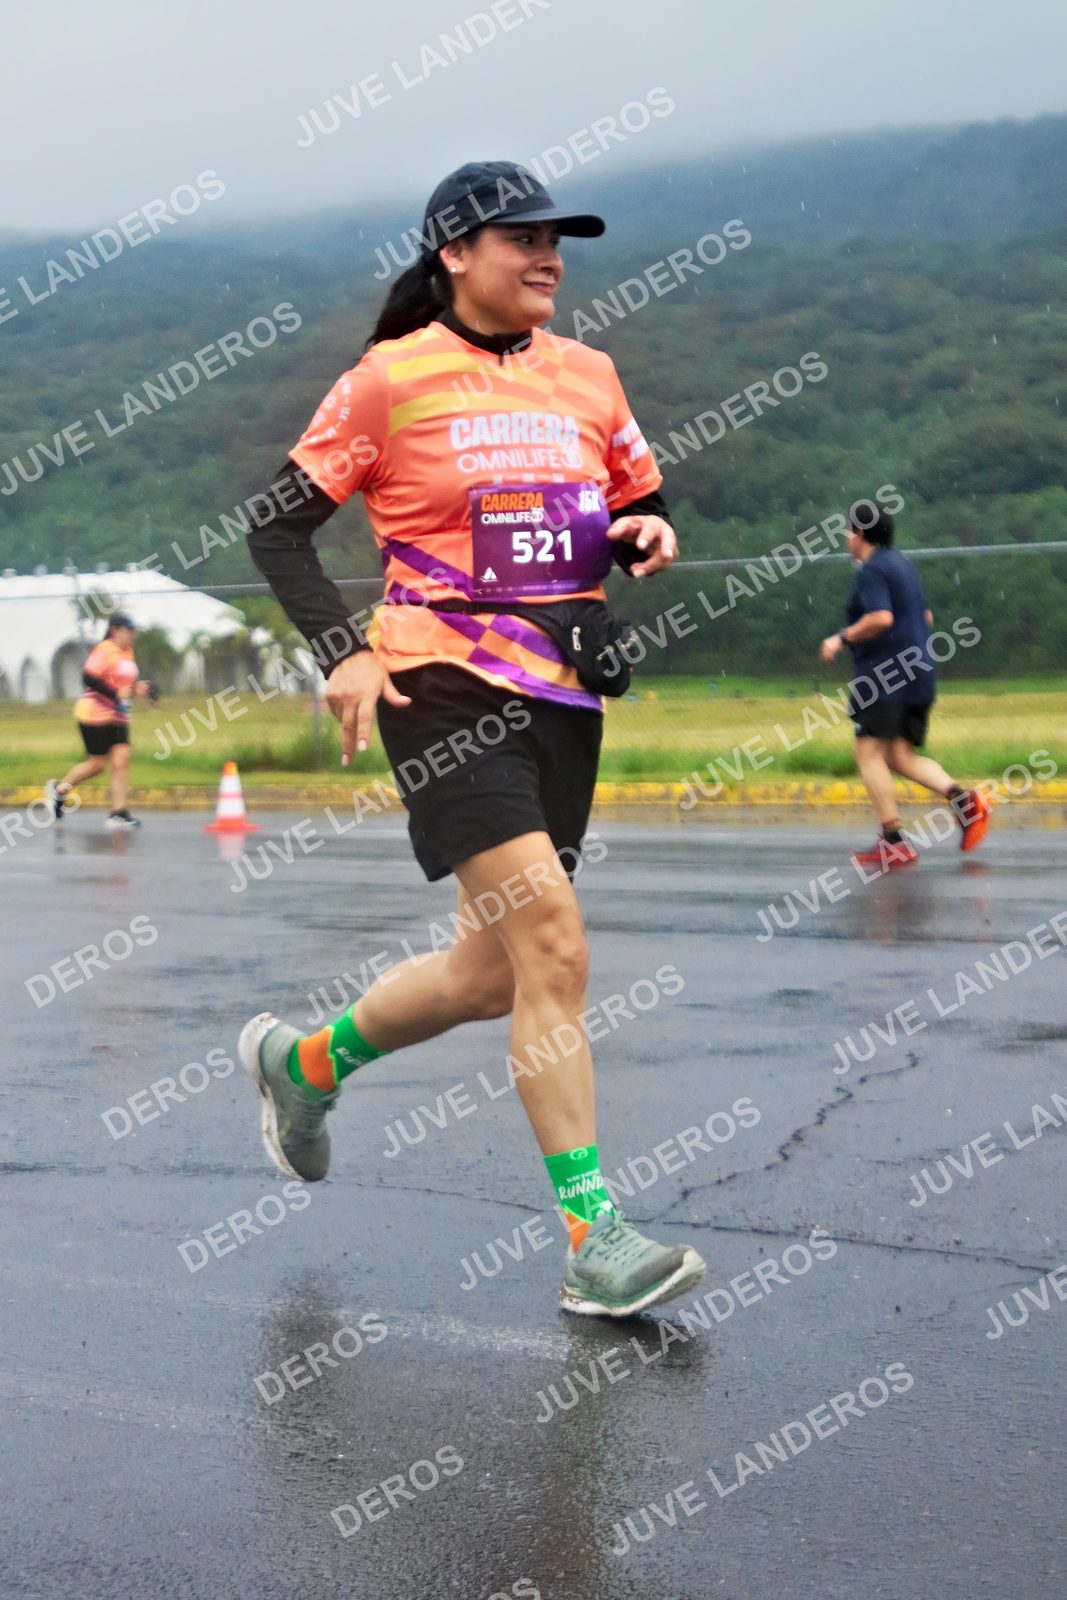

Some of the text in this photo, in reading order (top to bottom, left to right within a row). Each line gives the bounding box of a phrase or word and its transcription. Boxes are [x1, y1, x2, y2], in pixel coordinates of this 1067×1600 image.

[451, 411, 580, 449] CARRERA
[457, 448, 561, 473] OMNILIFE
[481, 491, 544, 512] CARRERA
[579, 490, 601, 512] 15K
[481, 511, 532, 524] OMNILIFE
[512, 529, 573, 564] 521
